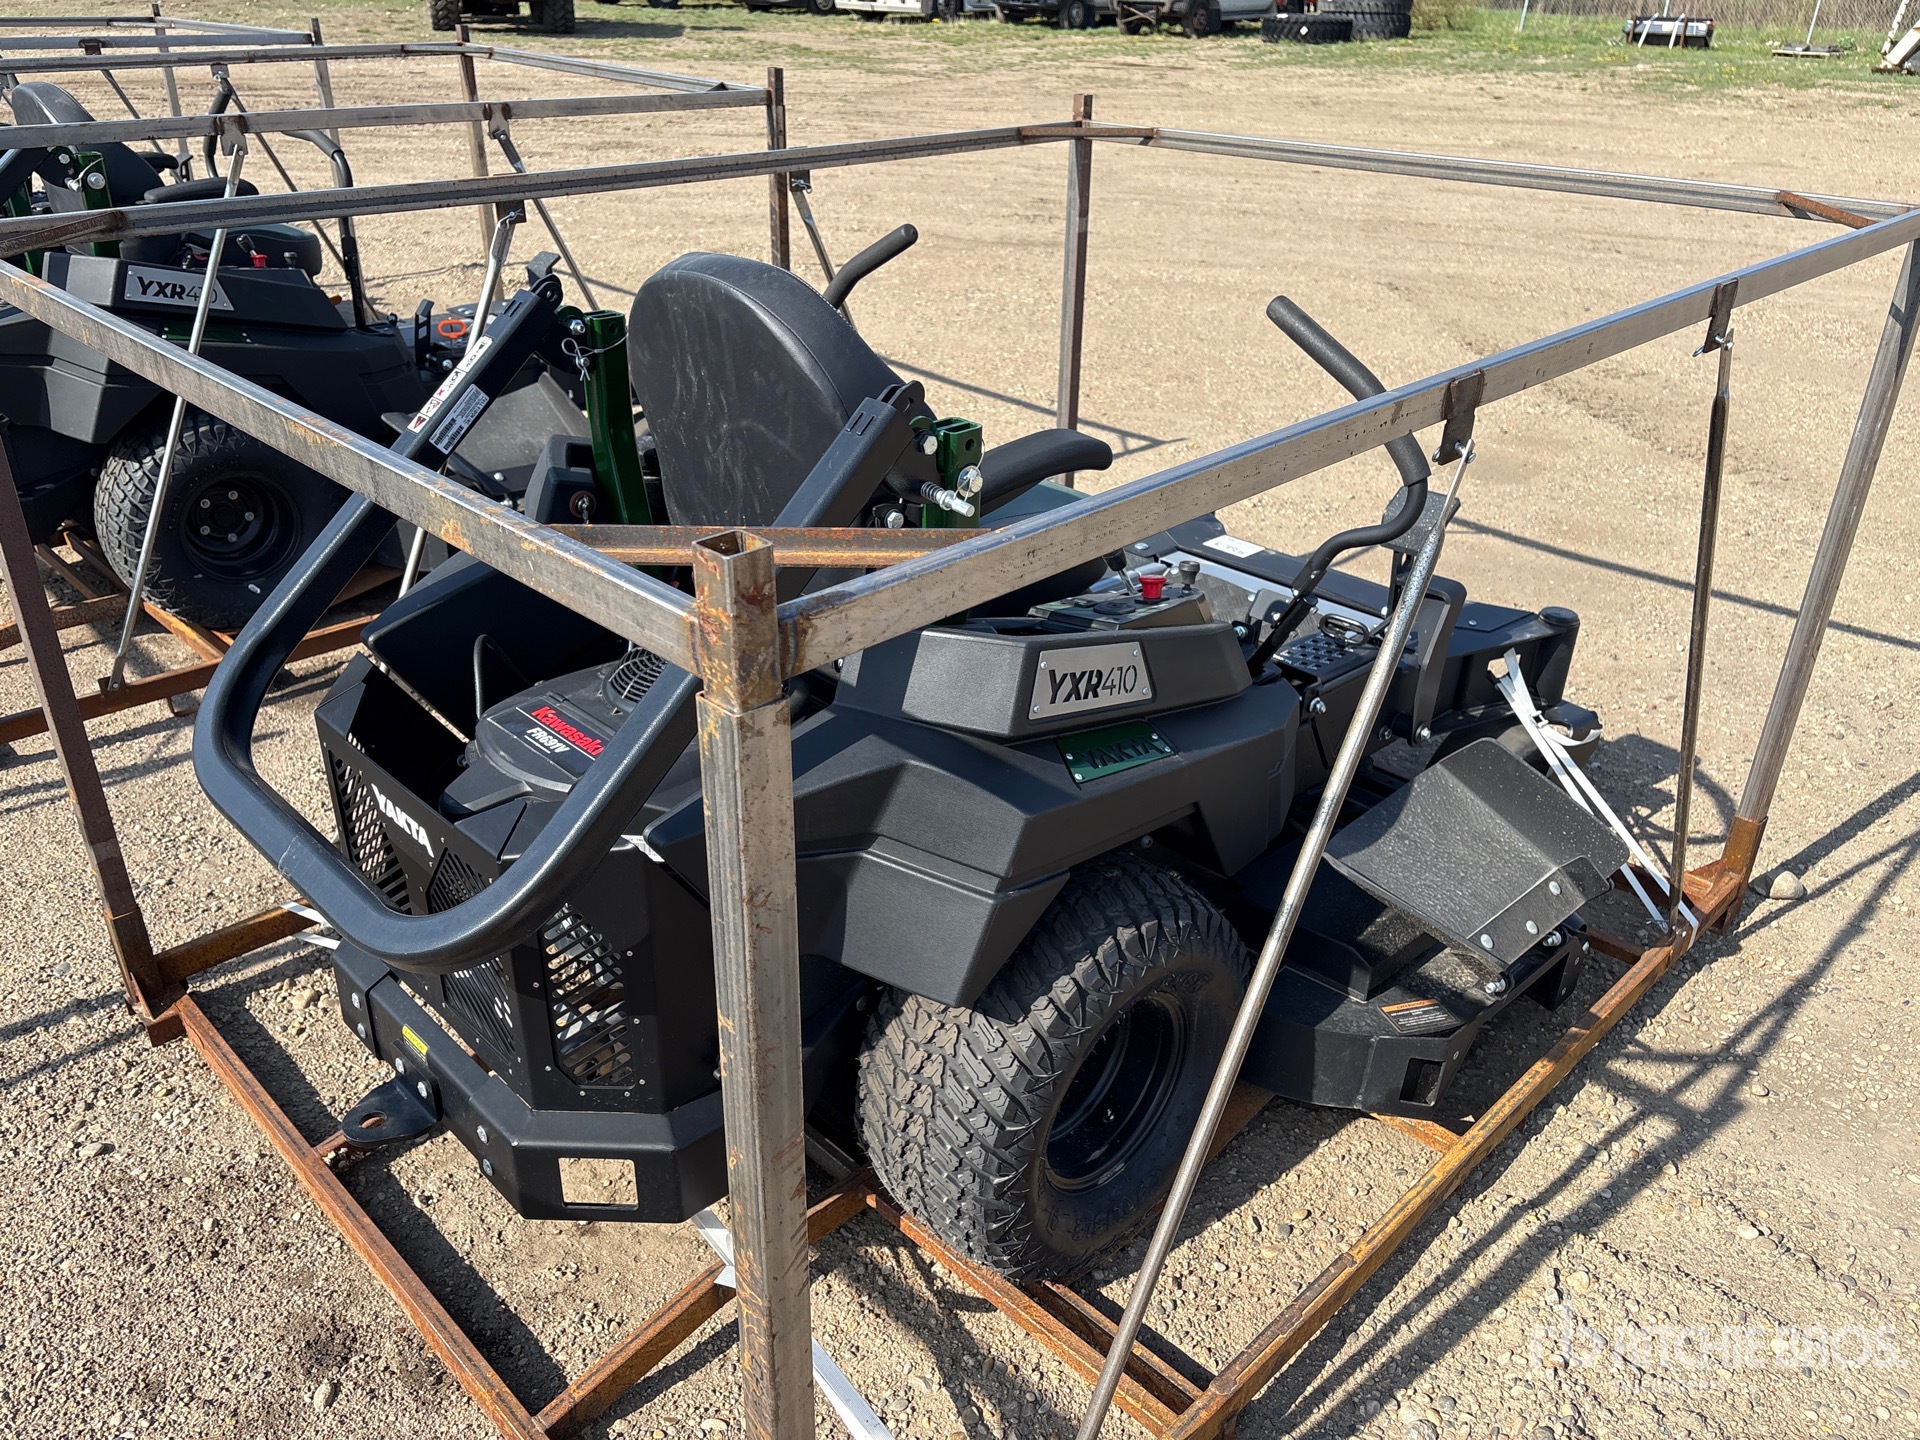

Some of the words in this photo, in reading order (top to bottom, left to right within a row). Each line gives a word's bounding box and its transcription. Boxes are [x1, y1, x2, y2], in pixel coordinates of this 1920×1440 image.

[1048, 664, 1138, 705] YXR410
[526, 727, 571, 753] FR691V
[1074, 736, 1166, 770] YAKTA
[370, 782, 435, 858] YAKTA
